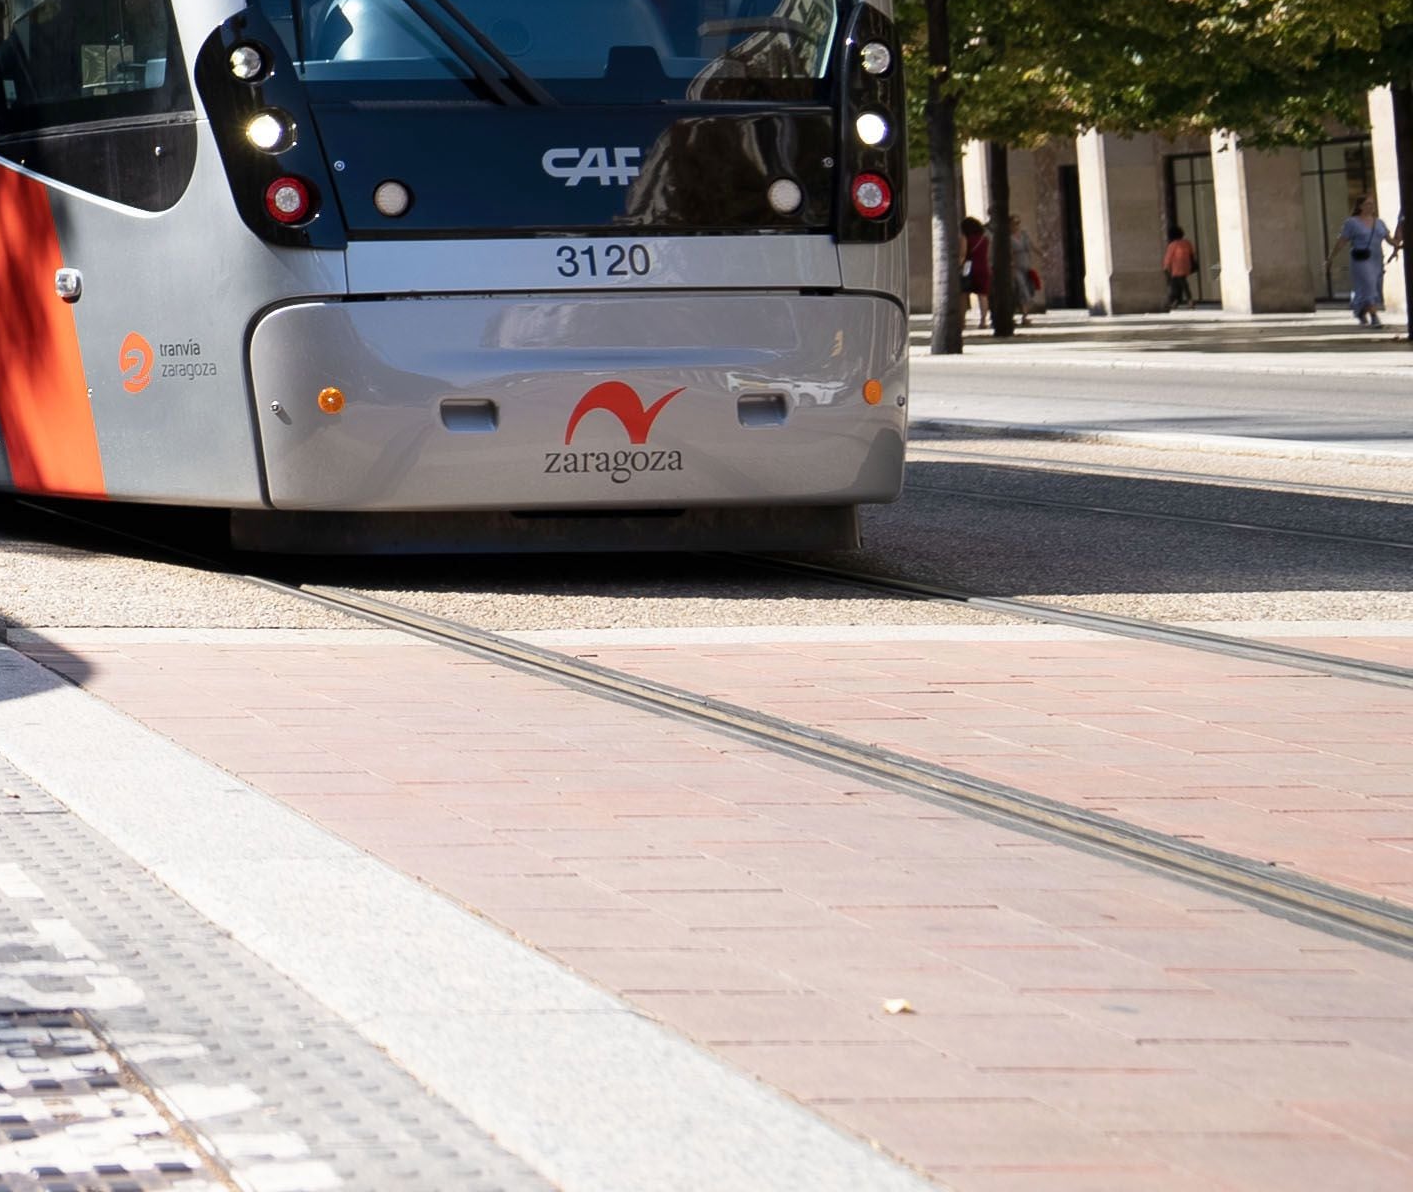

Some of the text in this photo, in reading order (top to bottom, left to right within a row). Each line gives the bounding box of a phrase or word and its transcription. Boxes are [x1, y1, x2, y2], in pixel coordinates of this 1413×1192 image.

[541, 147, 640, 186] CAF
[556, 244, 651, 277] 3120
[159, 338, 201, 357] tranvía
[161, 362, 217, 381] zaragoza
[543, 448, 684, 484] zaragoza
